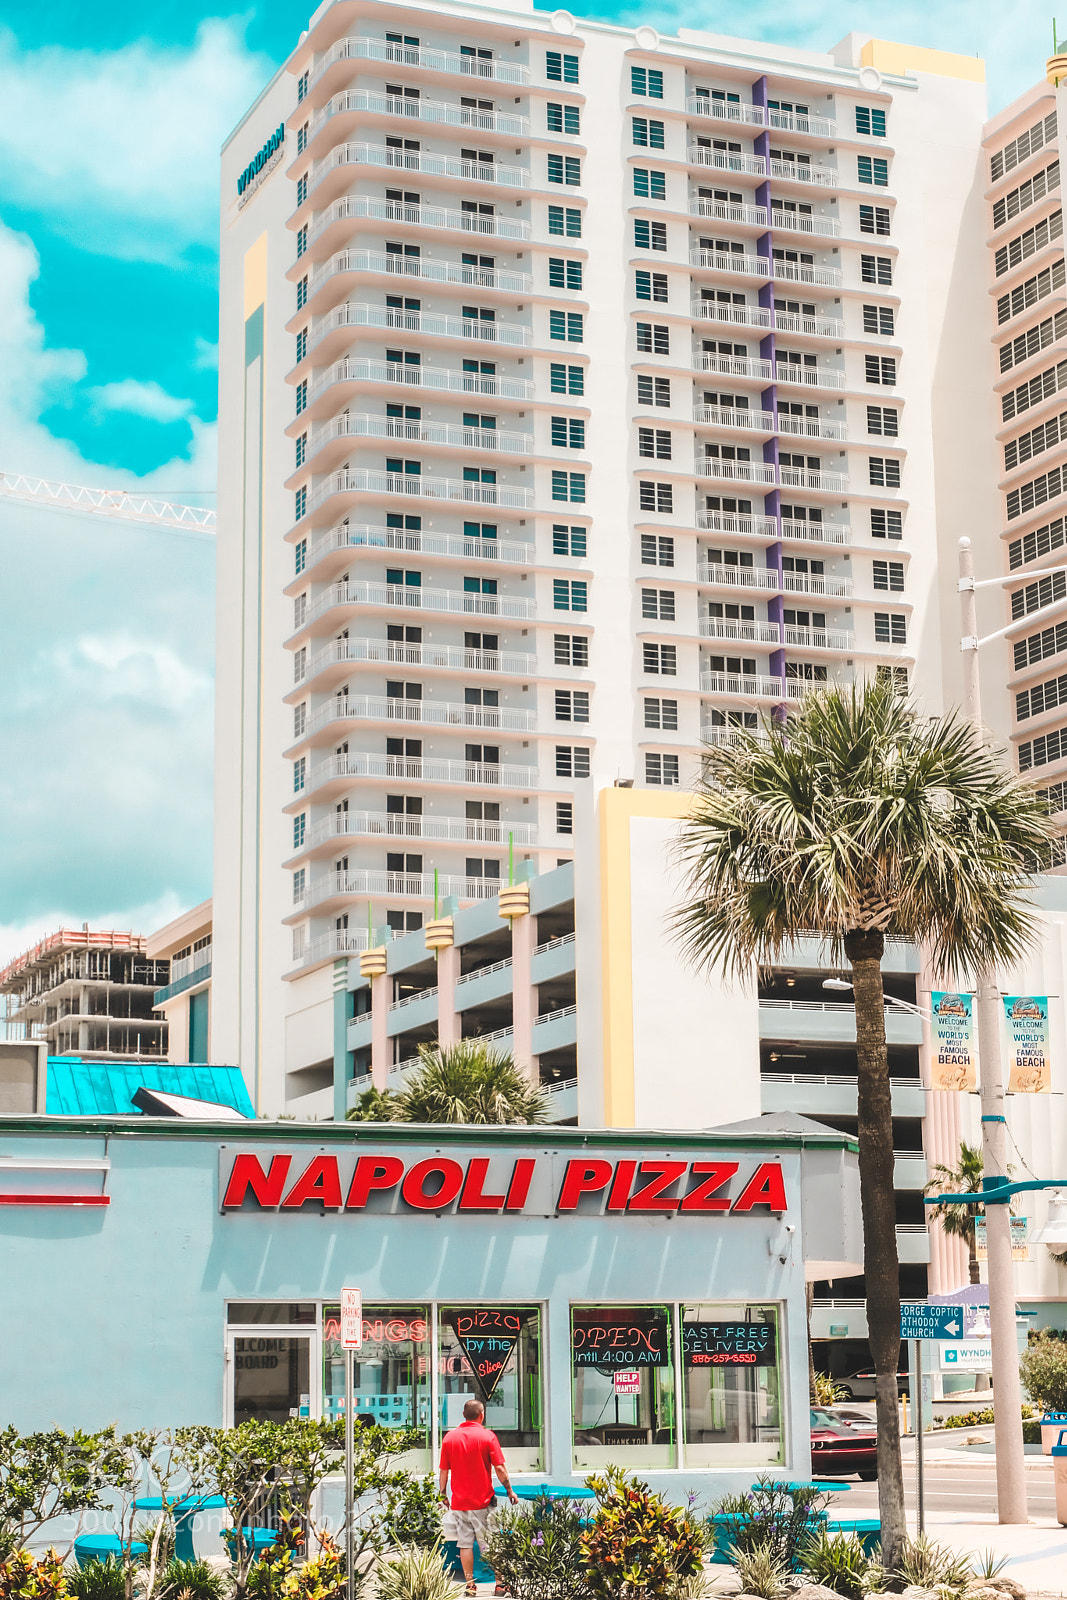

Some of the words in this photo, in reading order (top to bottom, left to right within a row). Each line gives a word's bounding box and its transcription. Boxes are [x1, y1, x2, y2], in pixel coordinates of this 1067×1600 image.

[237, 122, 285, 196] WYNDHAM
[938, 1017, 968, 1026] WELCOME
[1012, 1021, 1043, 1029] WELCOME
[938, 1031, 969, 1040] WORLD'S
[1013, 1034, 1045, 1042] WORLD'S
[940, 1046, 968, 1055] FAMOUS
[1016, 1049, 1043, 1057] FAMOUS
[938, 1054, 970, 1065] BEACH
[1016, 1057, 1045, 1067] BEACH
[223, 1154, 536, 1210] NAPOLI
[556, 1158, 788, 1212] PIZZA
[347, 1293, 355, 1305] NO
[342, 1306, 361, 1319] PARKING
[900, 1306, 926, 1316] EORGE
[930, 1307, 959, 1317] COPTIC
[457, 1310, 520, 1336] pizza
[901, 1317, 940, 1327] RTHODOX
[322, 1319, 427, 1342] WNGS
[726, 1327, 769, 1338] FREE
[901, 1327, 935, 1338] CHURCH
[570, 1327, 661, 1352] OPEN
[466, 1338, 484, 1353] by
[487, 1338, 511, 1351] the
[682, 1341, 767, 1352] DELIVERY
[602, 1350, 634, 1363] 4:00
[637, 1351, 661, 1362] AM
[960, 1349, 991, 1358] WYNDH
[235, 1355, 279, 1370] BOARD
[478, 1360, 503, 1377] Slice
[616, 1374, 638, 1383] HELP
[615, 1384, 640, 1393] WANTED
[606, 1438, 630, 1446] THANK
[632, 1438, 646, 1446] YOU
